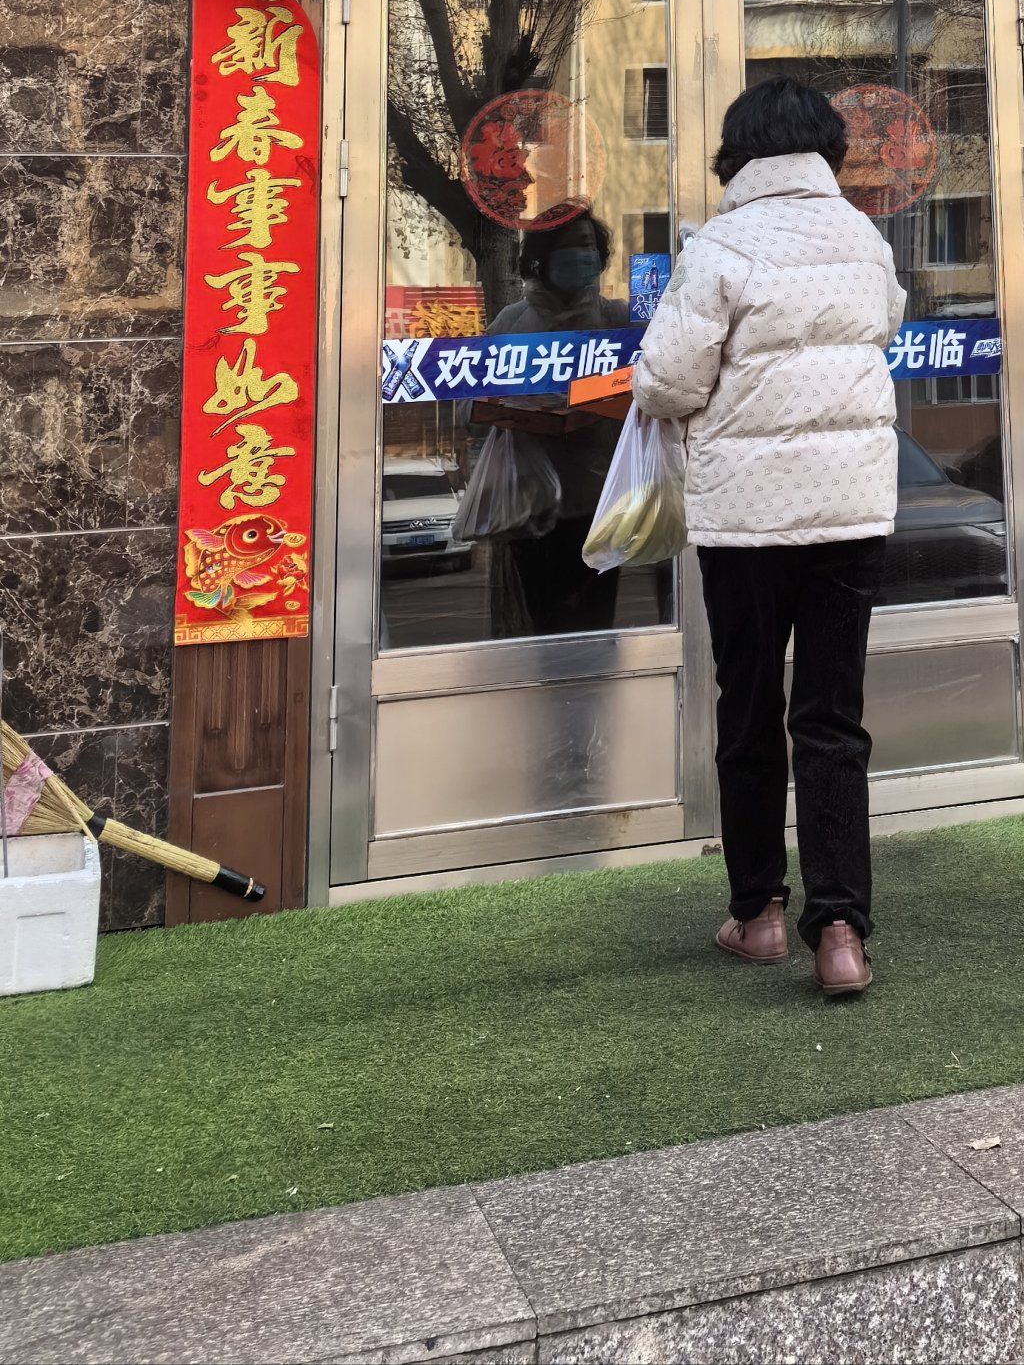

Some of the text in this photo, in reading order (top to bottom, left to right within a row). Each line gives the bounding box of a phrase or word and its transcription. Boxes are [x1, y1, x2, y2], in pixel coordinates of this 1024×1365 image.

[435, 338, 621, 391] 欢迎光临
[888, 328, 967, 371] 光临
